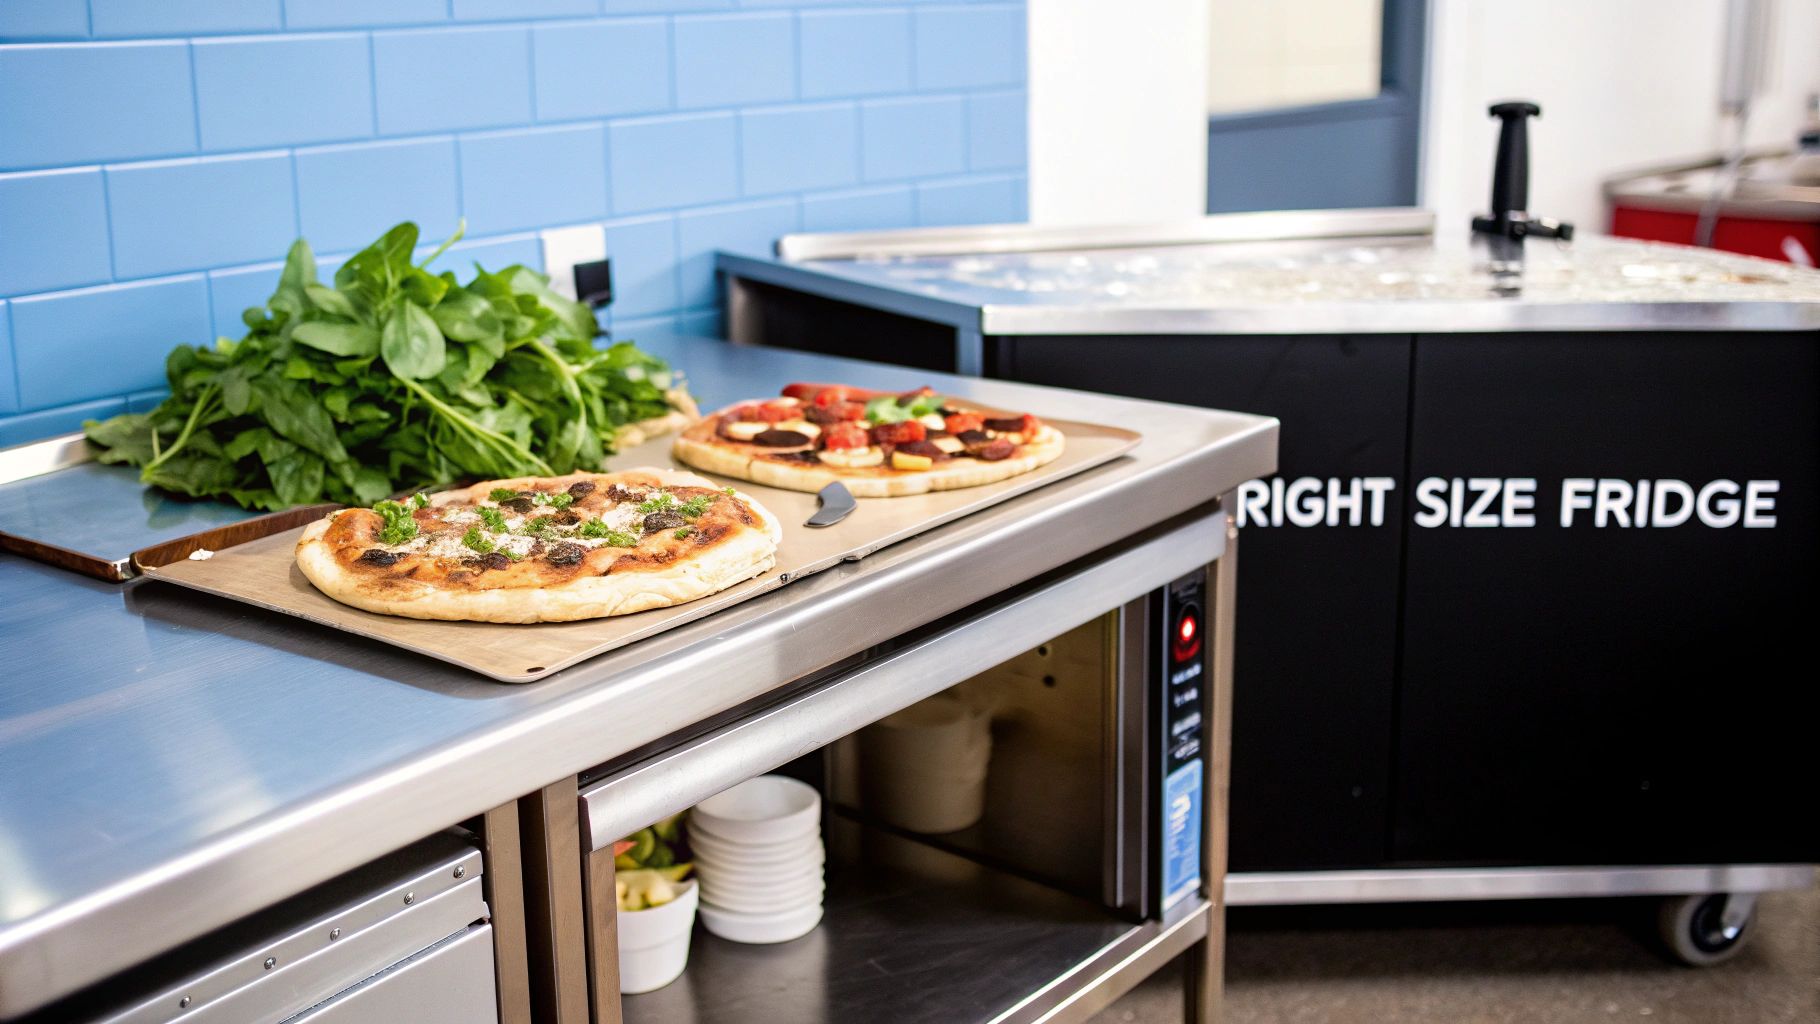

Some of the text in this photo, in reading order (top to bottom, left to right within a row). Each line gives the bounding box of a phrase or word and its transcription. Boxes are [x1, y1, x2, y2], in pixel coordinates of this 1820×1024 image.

[1237, 477, 1780, 528] RIGHT SIZE FRIDGE
